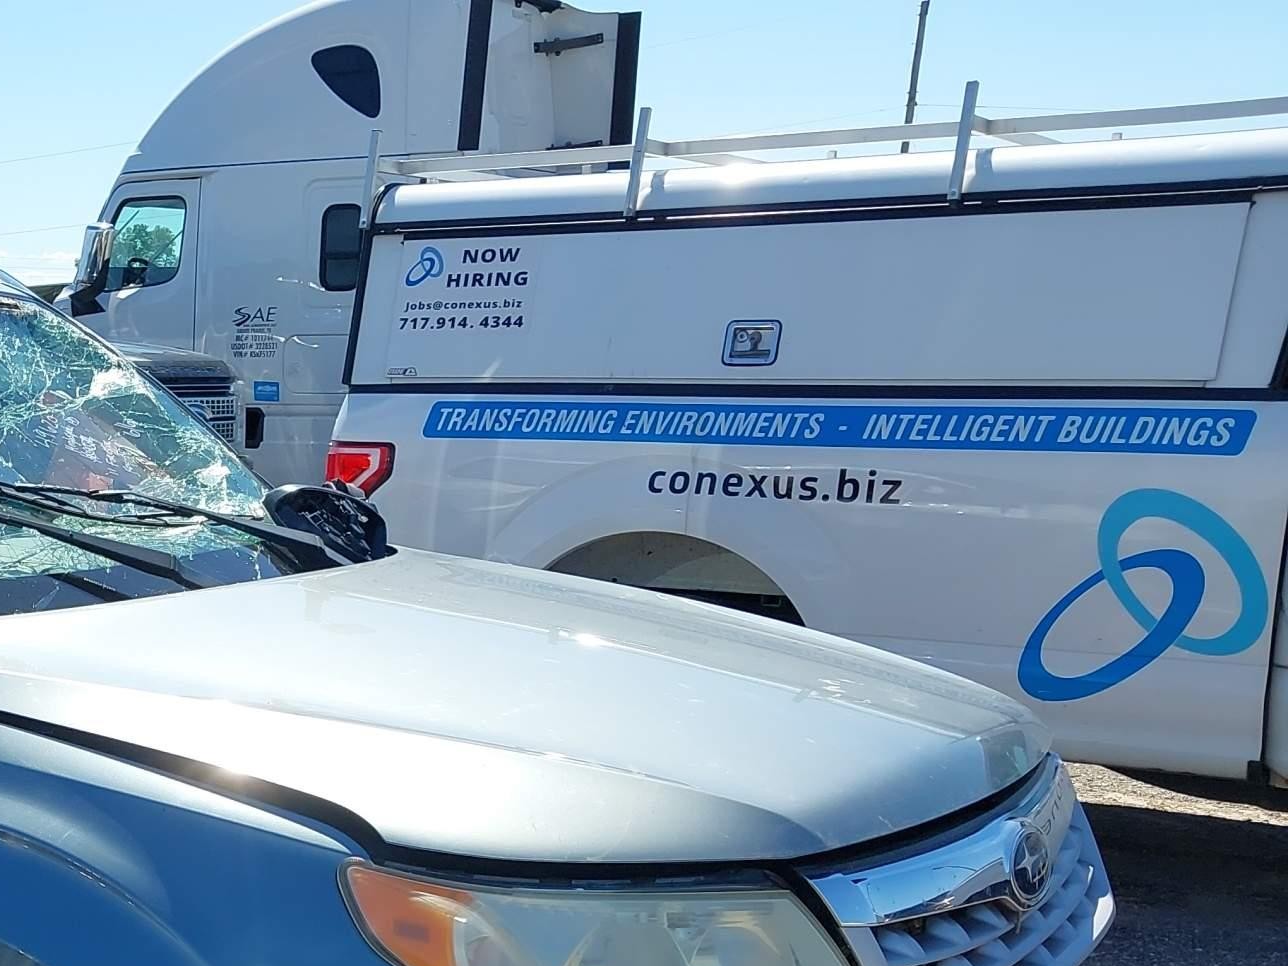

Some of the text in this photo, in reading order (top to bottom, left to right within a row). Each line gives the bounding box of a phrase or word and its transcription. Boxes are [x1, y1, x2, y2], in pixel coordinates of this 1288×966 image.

[462, 247, 521, 264] NOW
[446, 271, 529, 288] HIRING
[232, 306, 279, 327] SAE
[435, 407, 618, 434] TRANSFORMING
[620, 409, 825, 439] ENVIRONMENTS
[861, 413, 1057, 444] INTELLIGENT
[1056, 415, 1236, 447] BUILDINGS
[648, 468, 903, 504] conexus.biz
